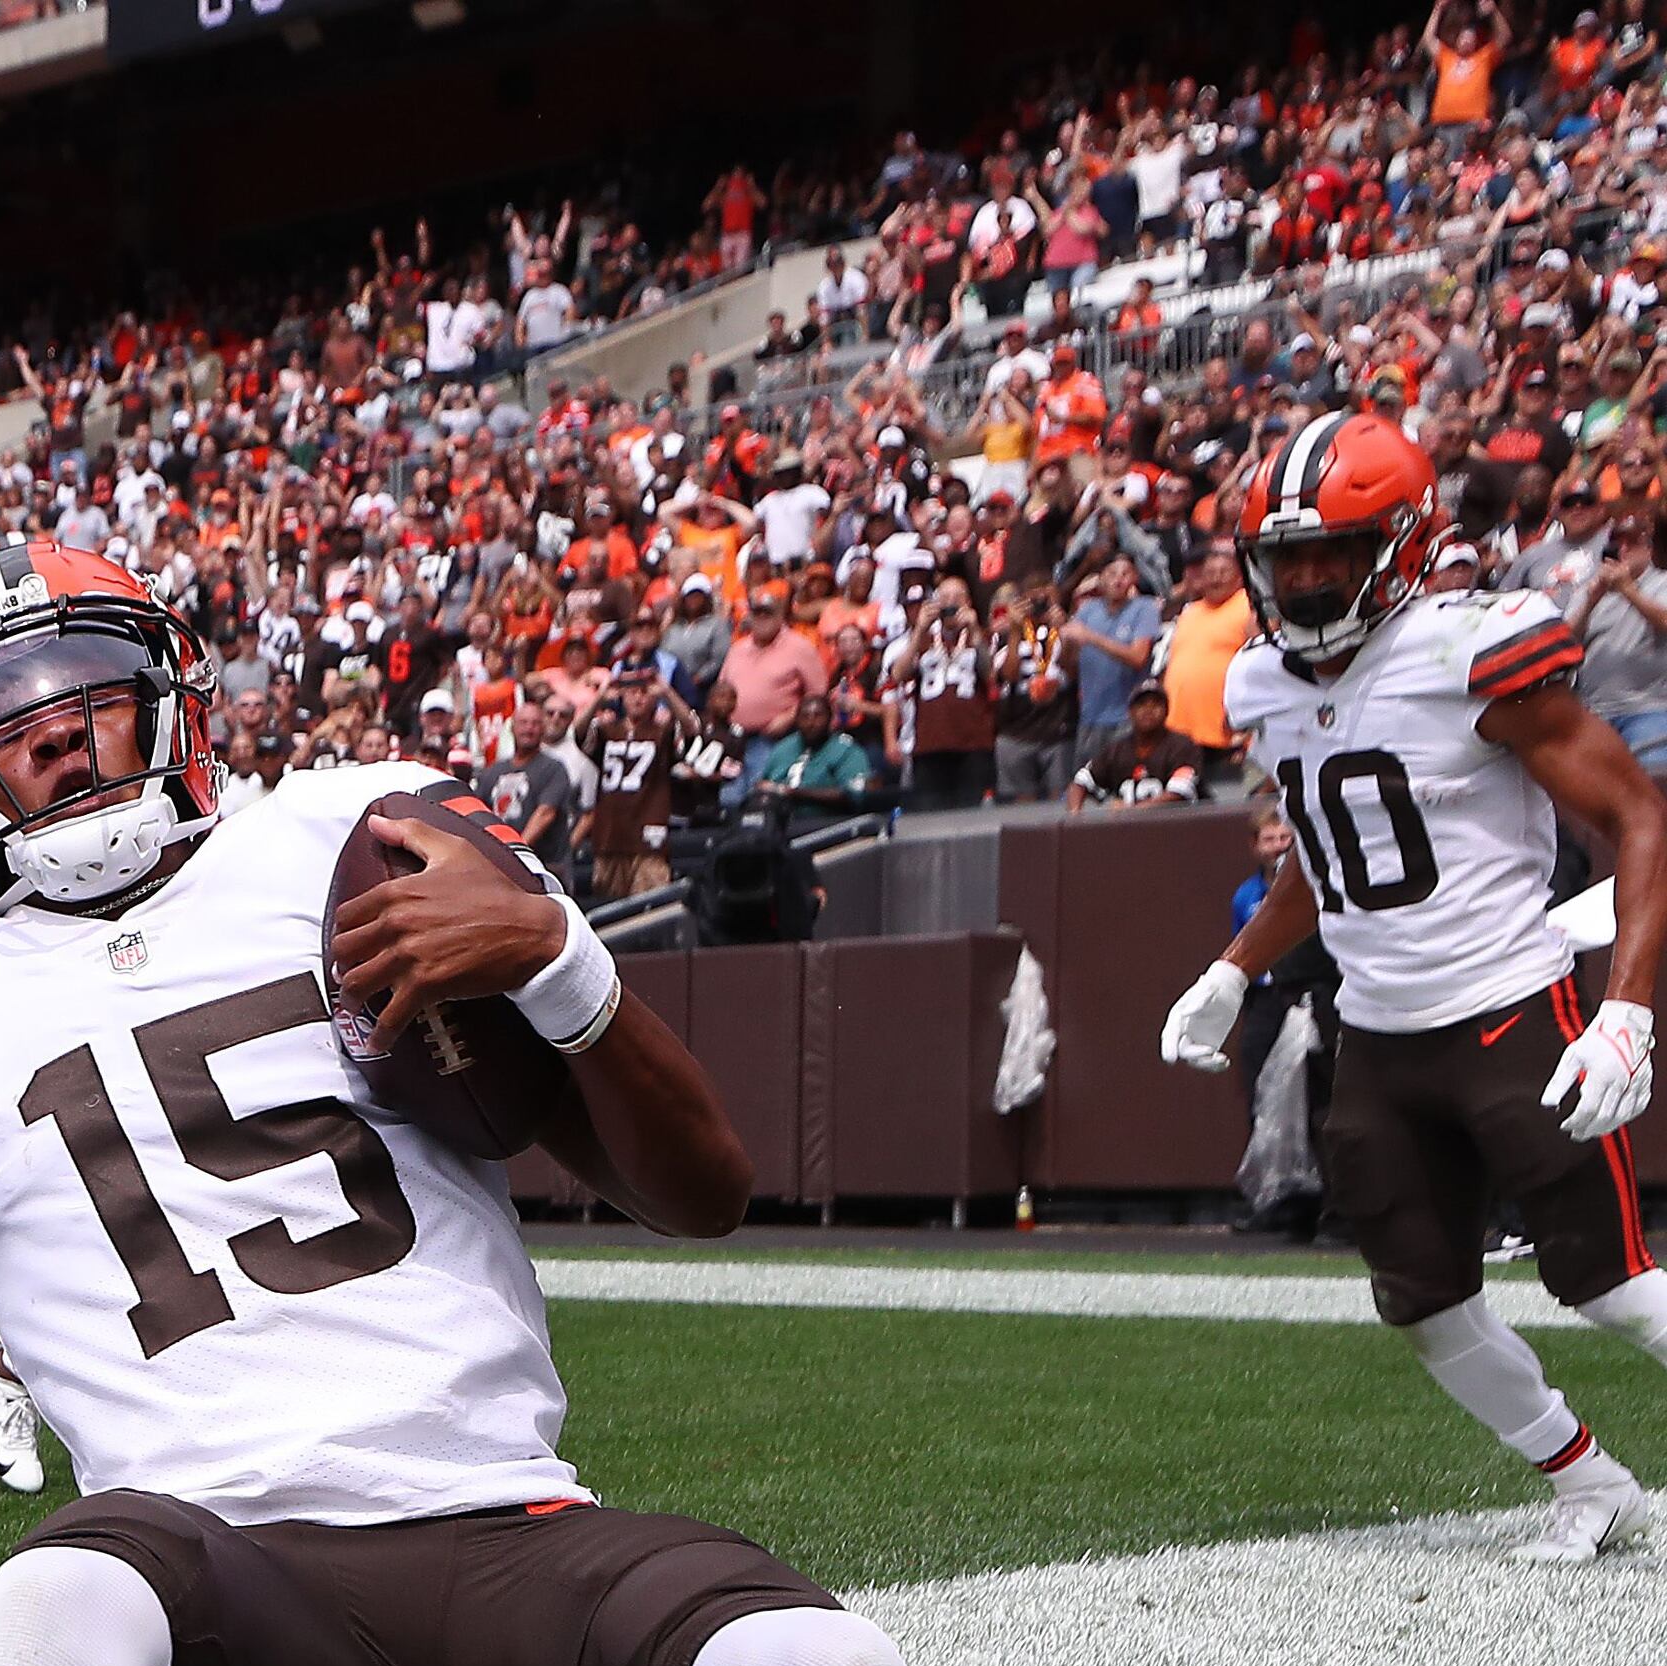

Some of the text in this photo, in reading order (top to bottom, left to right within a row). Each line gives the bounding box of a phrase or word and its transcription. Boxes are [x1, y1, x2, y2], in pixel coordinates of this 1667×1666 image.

[388, 640, 413, 684] 6
[920, 647, 977, 702] 84
[601, 740, 656, 793] 57
[1277, 750, 1439, 913] 10
[113, 946, 146, 968] NFL
[19, 971, 417, 1350] 15
